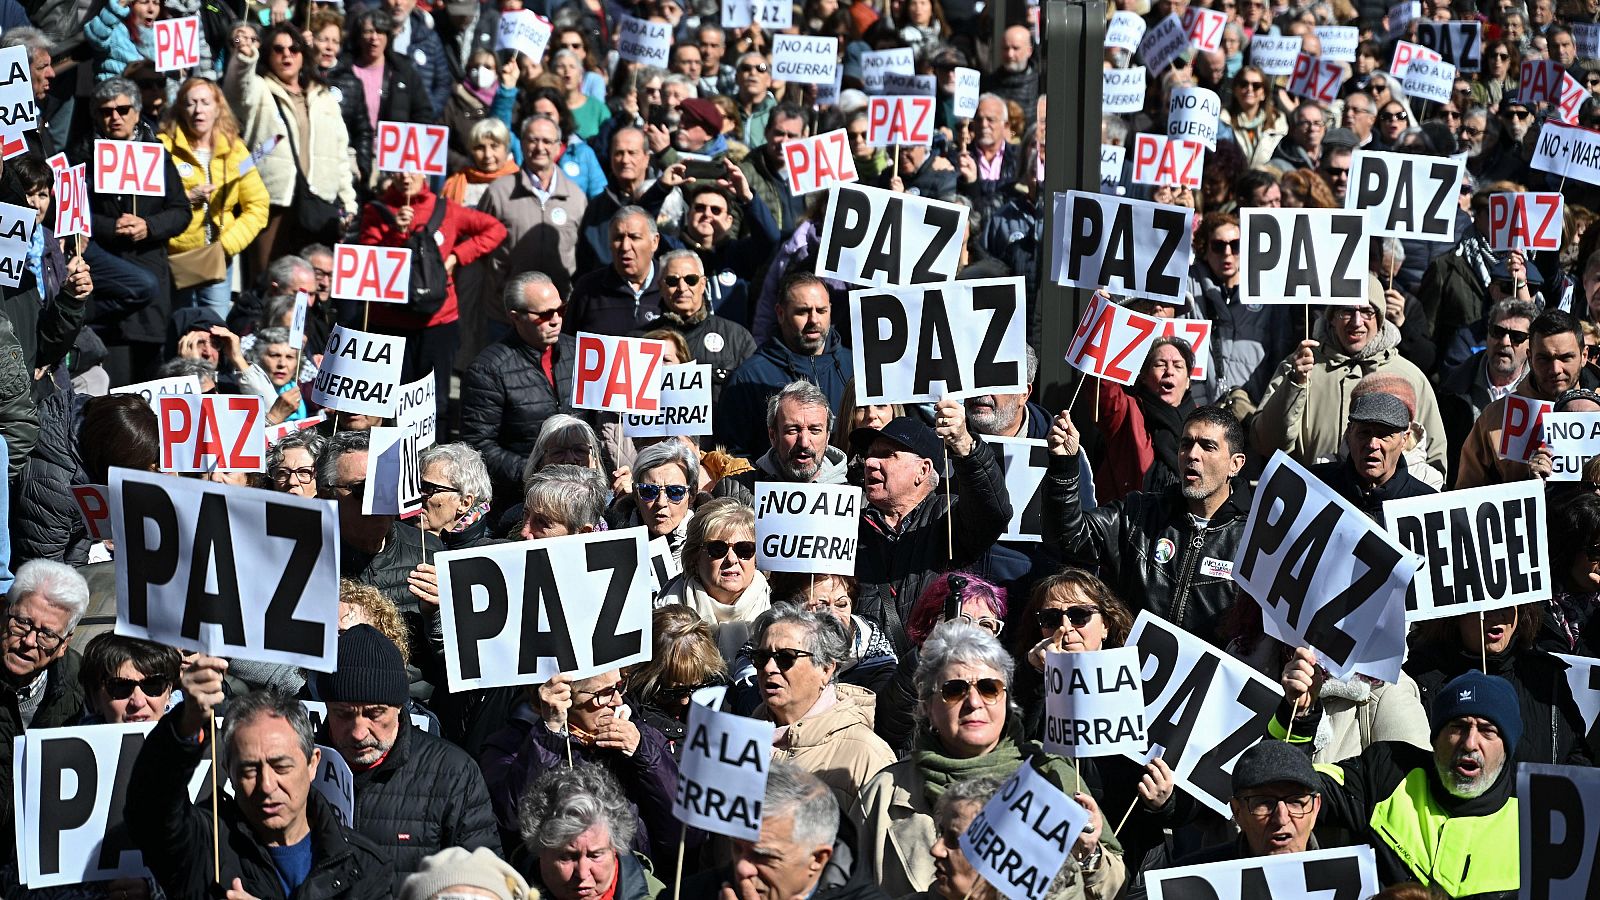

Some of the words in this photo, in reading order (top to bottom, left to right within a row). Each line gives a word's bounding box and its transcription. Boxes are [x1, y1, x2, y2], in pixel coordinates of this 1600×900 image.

[650, 27, 665, 40] LA
[728, 5, 736, 20] Y
[156, 19, 198, 67] PAZ
[621, 42, 667, 59] GUERRA!
[775, 41, 801, 54] ¡NO
[804, 42, 813, 53] A
[816, 43, 832, 54] LA
[885, 56, 893, 65] A
[897, 55, 911, 65] LA
[776, 61, 833, 75] GUERRA!
[1124, 75, 1131, 84] A
[1291, 55, 1343, 102] PAZ
[1430, 65, 1438, 75] A
[1520, 61, 1564, 105] PAZ
[870, 98, 932, 142] PAZ
[1171, 95, 1197, 113] ¡NO
[1200, 98, 1210, 113] A
[97, 143, 161, 193] PAZ
[379, 125, 445, 174] PAZ
[785, 131, 855, 192] PAZ
[1136, 136, 1202, 185] PAZ
[1540, 133, 1561, 157] NO
[1562, 141, 1569, 157] +
[1357, 157, 1458, 236] PAZ
[826, 187, 960, 284] PAZ
[1068, 195, 1187, 296] PAZ
[1490, 194, 1560, 249] PAZ
[335, 248, 408, 300] PAZ
[1248, 213, 1363, 298] PAZ
[340, 337, 357, 360] A
[362, 340, 391, 364] LA
[859, 284, 1019, 398] PAZ
[1067, 292, 1158, 383] PAZ
[576, 336, 662, 410] PAZ
[680, 371, 703, 390] LA
[399, 387, 424, 416] ¡NO
[160, 397, 260, 469] PAZ
[1546, 421, 1585, 445] ¡NO
[758, 490, 806, 519] ¡NO
[809, 491, 829, 515] A
[835, 493, 855, 517] LA
[122, 480, 325, 658] PAZ
[762, 533, 857, 562] GUERRA!
[1239, 461, 1403, 667] PAZ
[1397, 496, 1543, 610] PEACE!
[448, 538, 642, 680] PAZ
[1068, 667, 1090, 695] A
[1098, 664, 1138, 693] LA
[1047, 714, 1145, 746] GUERRA!
[1137, 622, 1285, 808] PAZ
[690, 723, 710, 758] A
[720, 732, 762, 773] LA
[1011, 789, 1032, 823] A
[1034, 804, 1070, 854] LA
[967, 811, 1050, 900] GUERRA!
